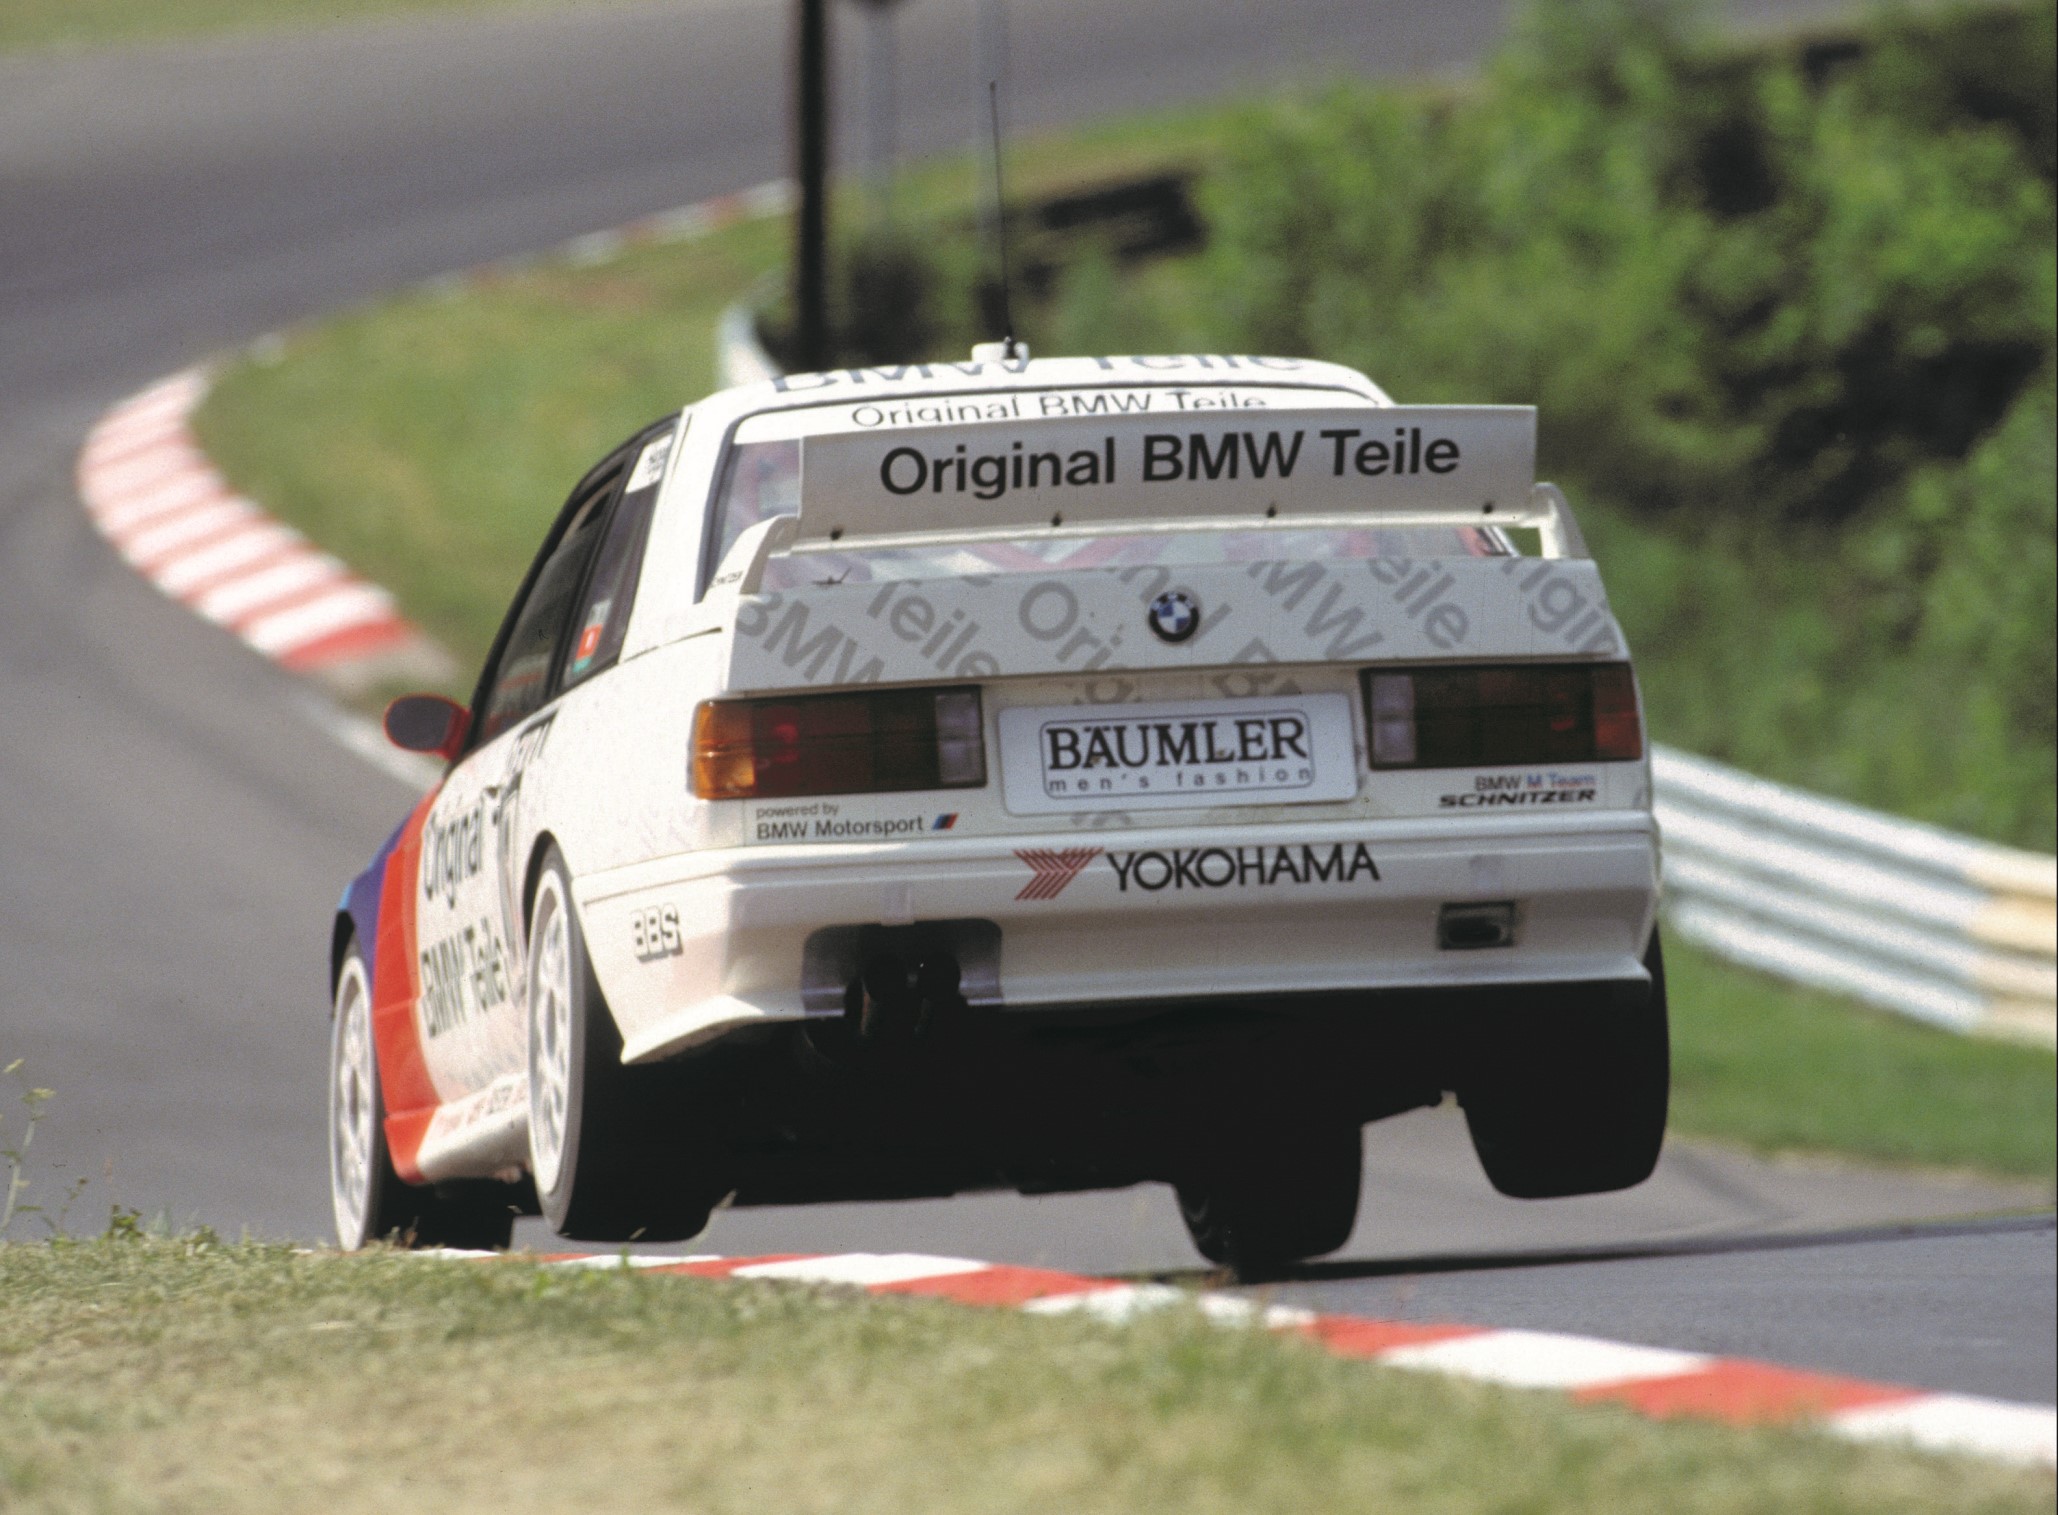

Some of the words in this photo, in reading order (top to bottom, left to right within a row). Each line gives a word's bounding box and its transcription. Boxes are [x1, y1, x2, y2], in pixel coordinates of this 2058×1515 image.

[1037, 393, 1152, 417] BMW
[880, 436, 1116, 500] Original
[1142, 431, 1304, 482] BMW
[1320, 427, 1460, 476] Teile
[1046, 717, 1308, 770] BÄUMLER
[1049, 773, 1150, 793] men's
[1175, 765, 1312, 788] fashion
[1474, 775, 1521, 792] BMW
[756, 804, 818, 820] powered
[822, 802, 839, 817] by
[1439, 788, 1596, 808] SCHNITZER
[757, 821, 807, 840] BMW
[815, 815, 924, 838] Motorsport
[1107, 842, 1381, 891] YOKOHAMA
[629, 902, 684, 963] BBS
